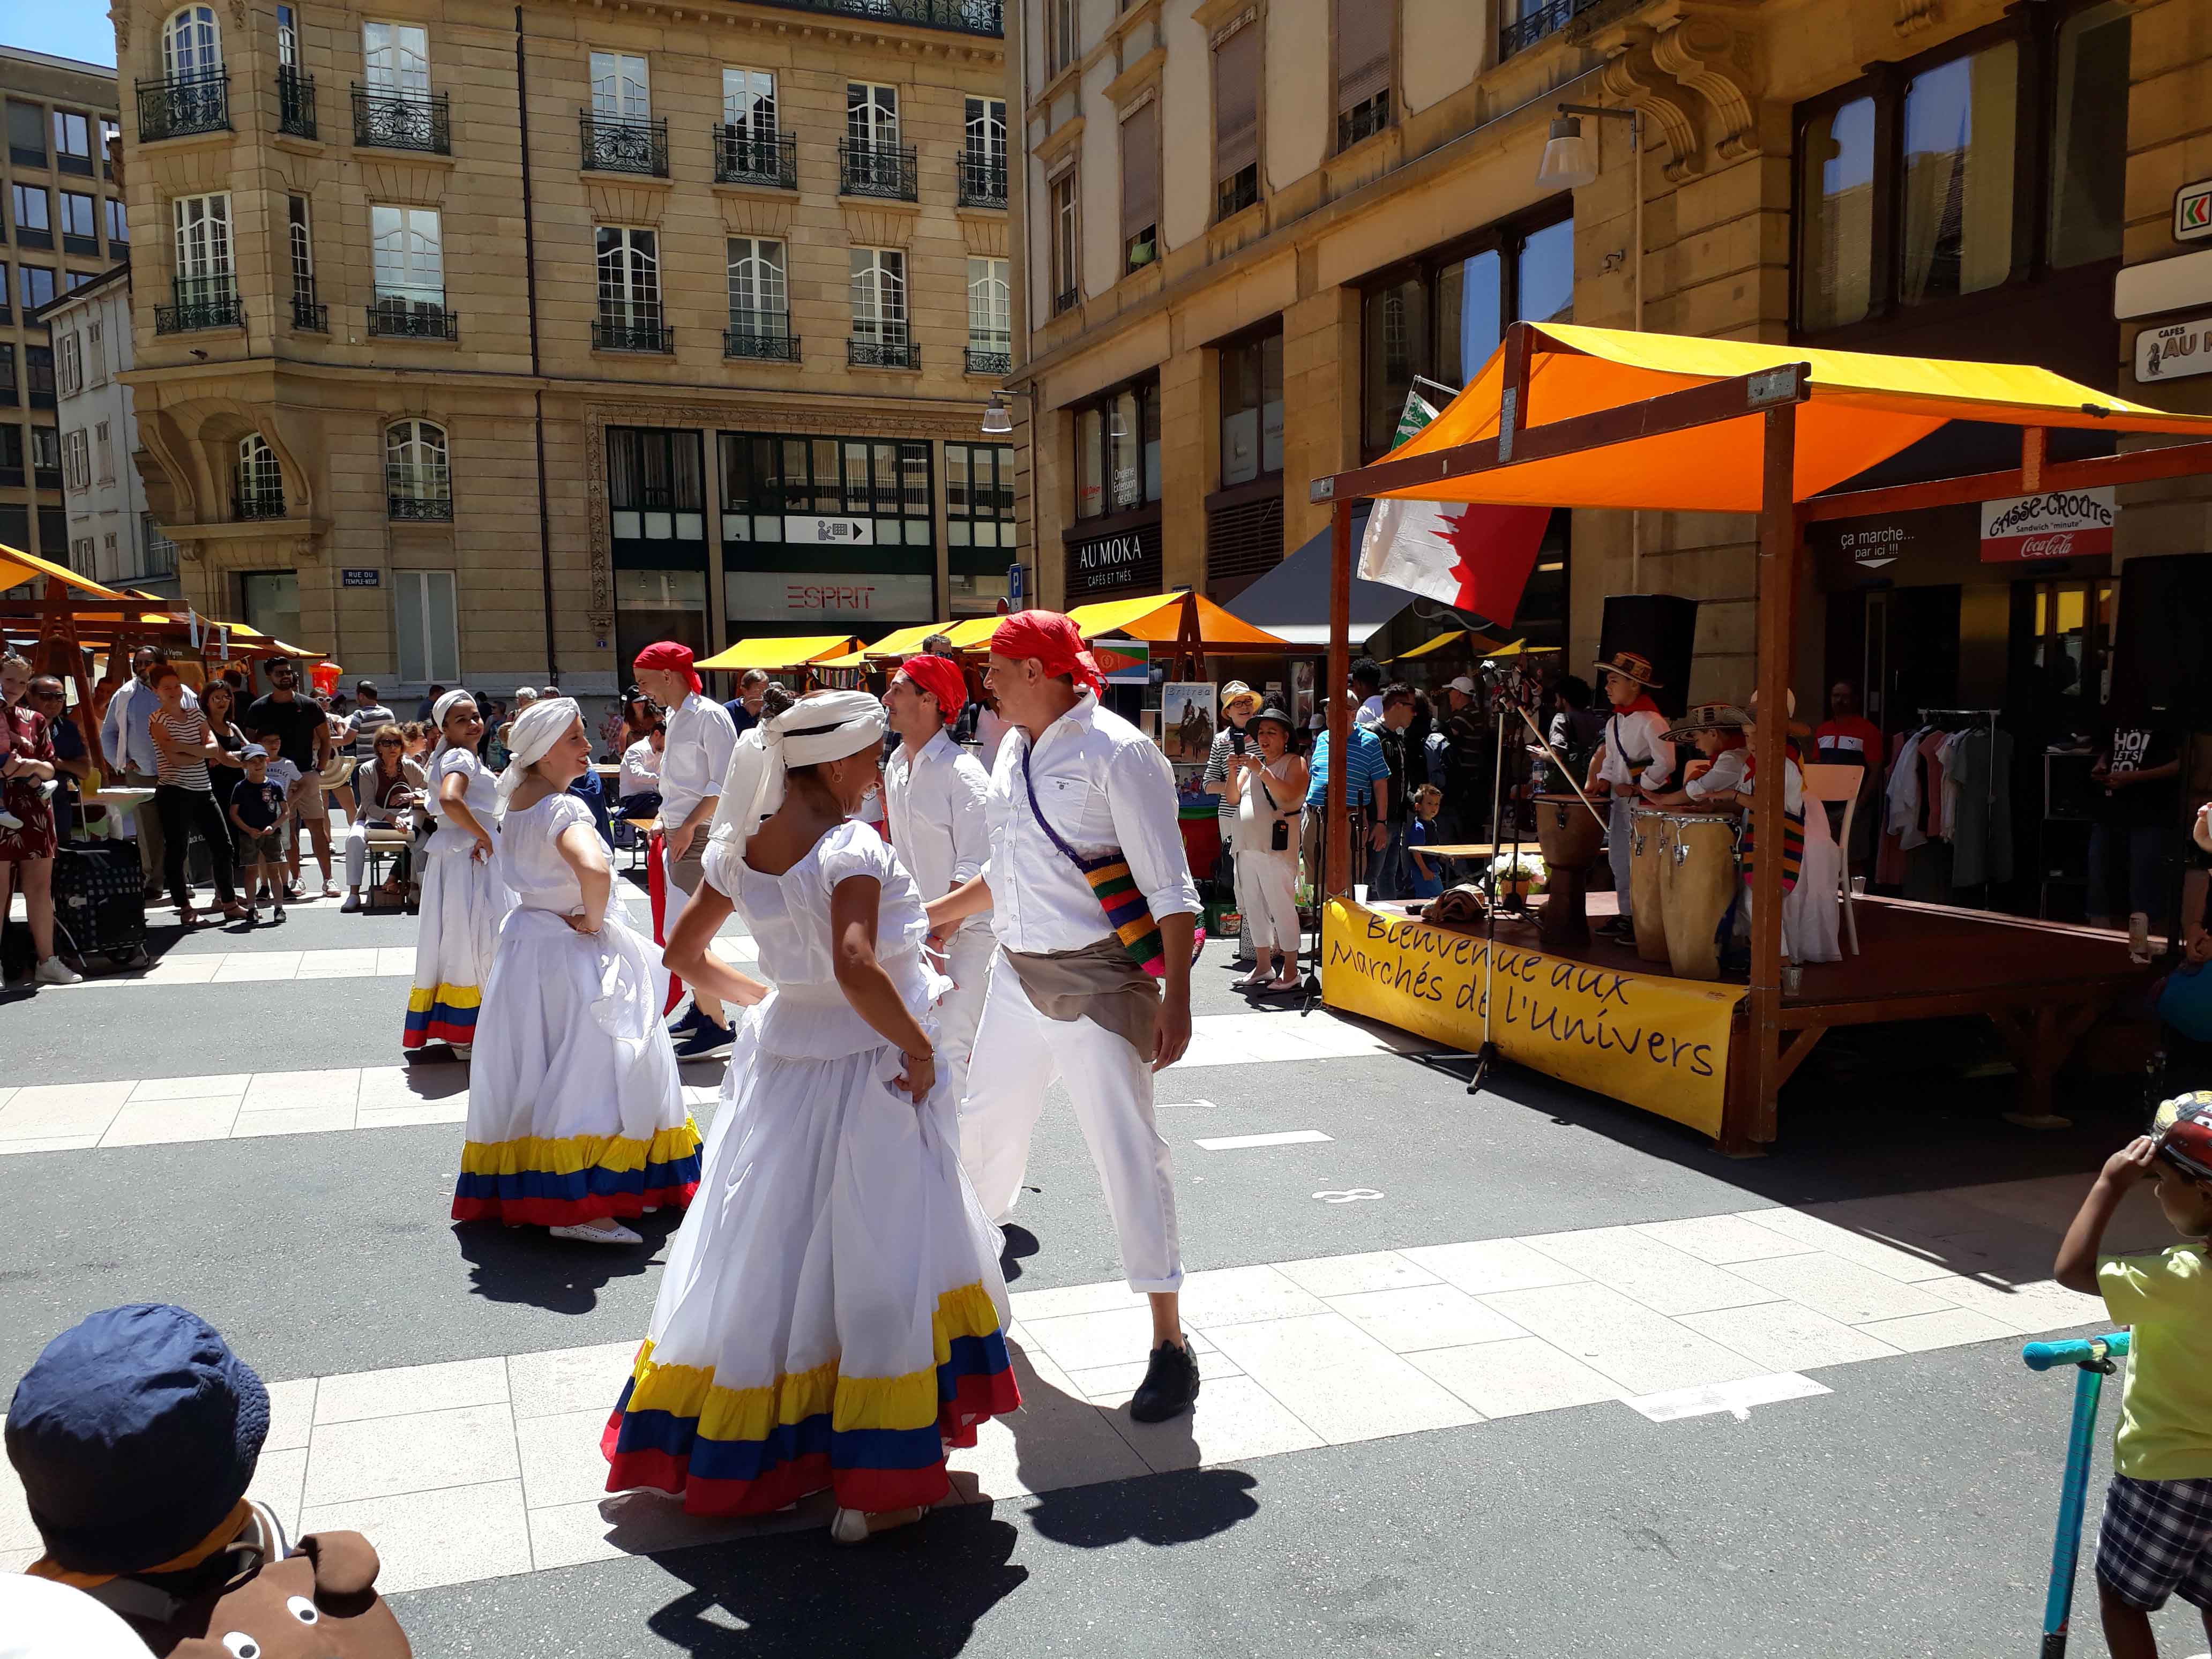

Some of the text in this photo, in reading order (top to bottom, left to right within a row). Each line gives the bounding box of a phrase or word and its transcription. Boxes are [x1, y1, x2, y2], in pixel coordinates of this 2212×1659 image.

[2162, 333, 2196, 360] AU
[1114, 465, 1134, 481] Onglerie
[1114, 479, 1137, 494] Extension
[1117, 494, 1124, 504] de
[1841, 526, 1915, 549] ça marche...
[2016, 524, 2049, 533] Sandwich
[1080, 535, 1142, 569] AU MOKA
[1855, 543, 1898, 560] par ici !!!
[2021, 534, 2075, 557] Coca-Cola
[1013, 572, 1019, 595] P
[1088, 572, 1105, 587] CAFÉS
[1107, 572, 1115, 584] ET
[787, 586, 875, 609] ESPRIT
[1168, 687, 1210, 696] Eritrea
[2113, 751, 2139, 761] LET'S
[1367, 914, 1634, 1005] Bienvenue aux
[1331, 940, 1443, 1001] Marchés
[1455, 974, 1488, 1018] de
